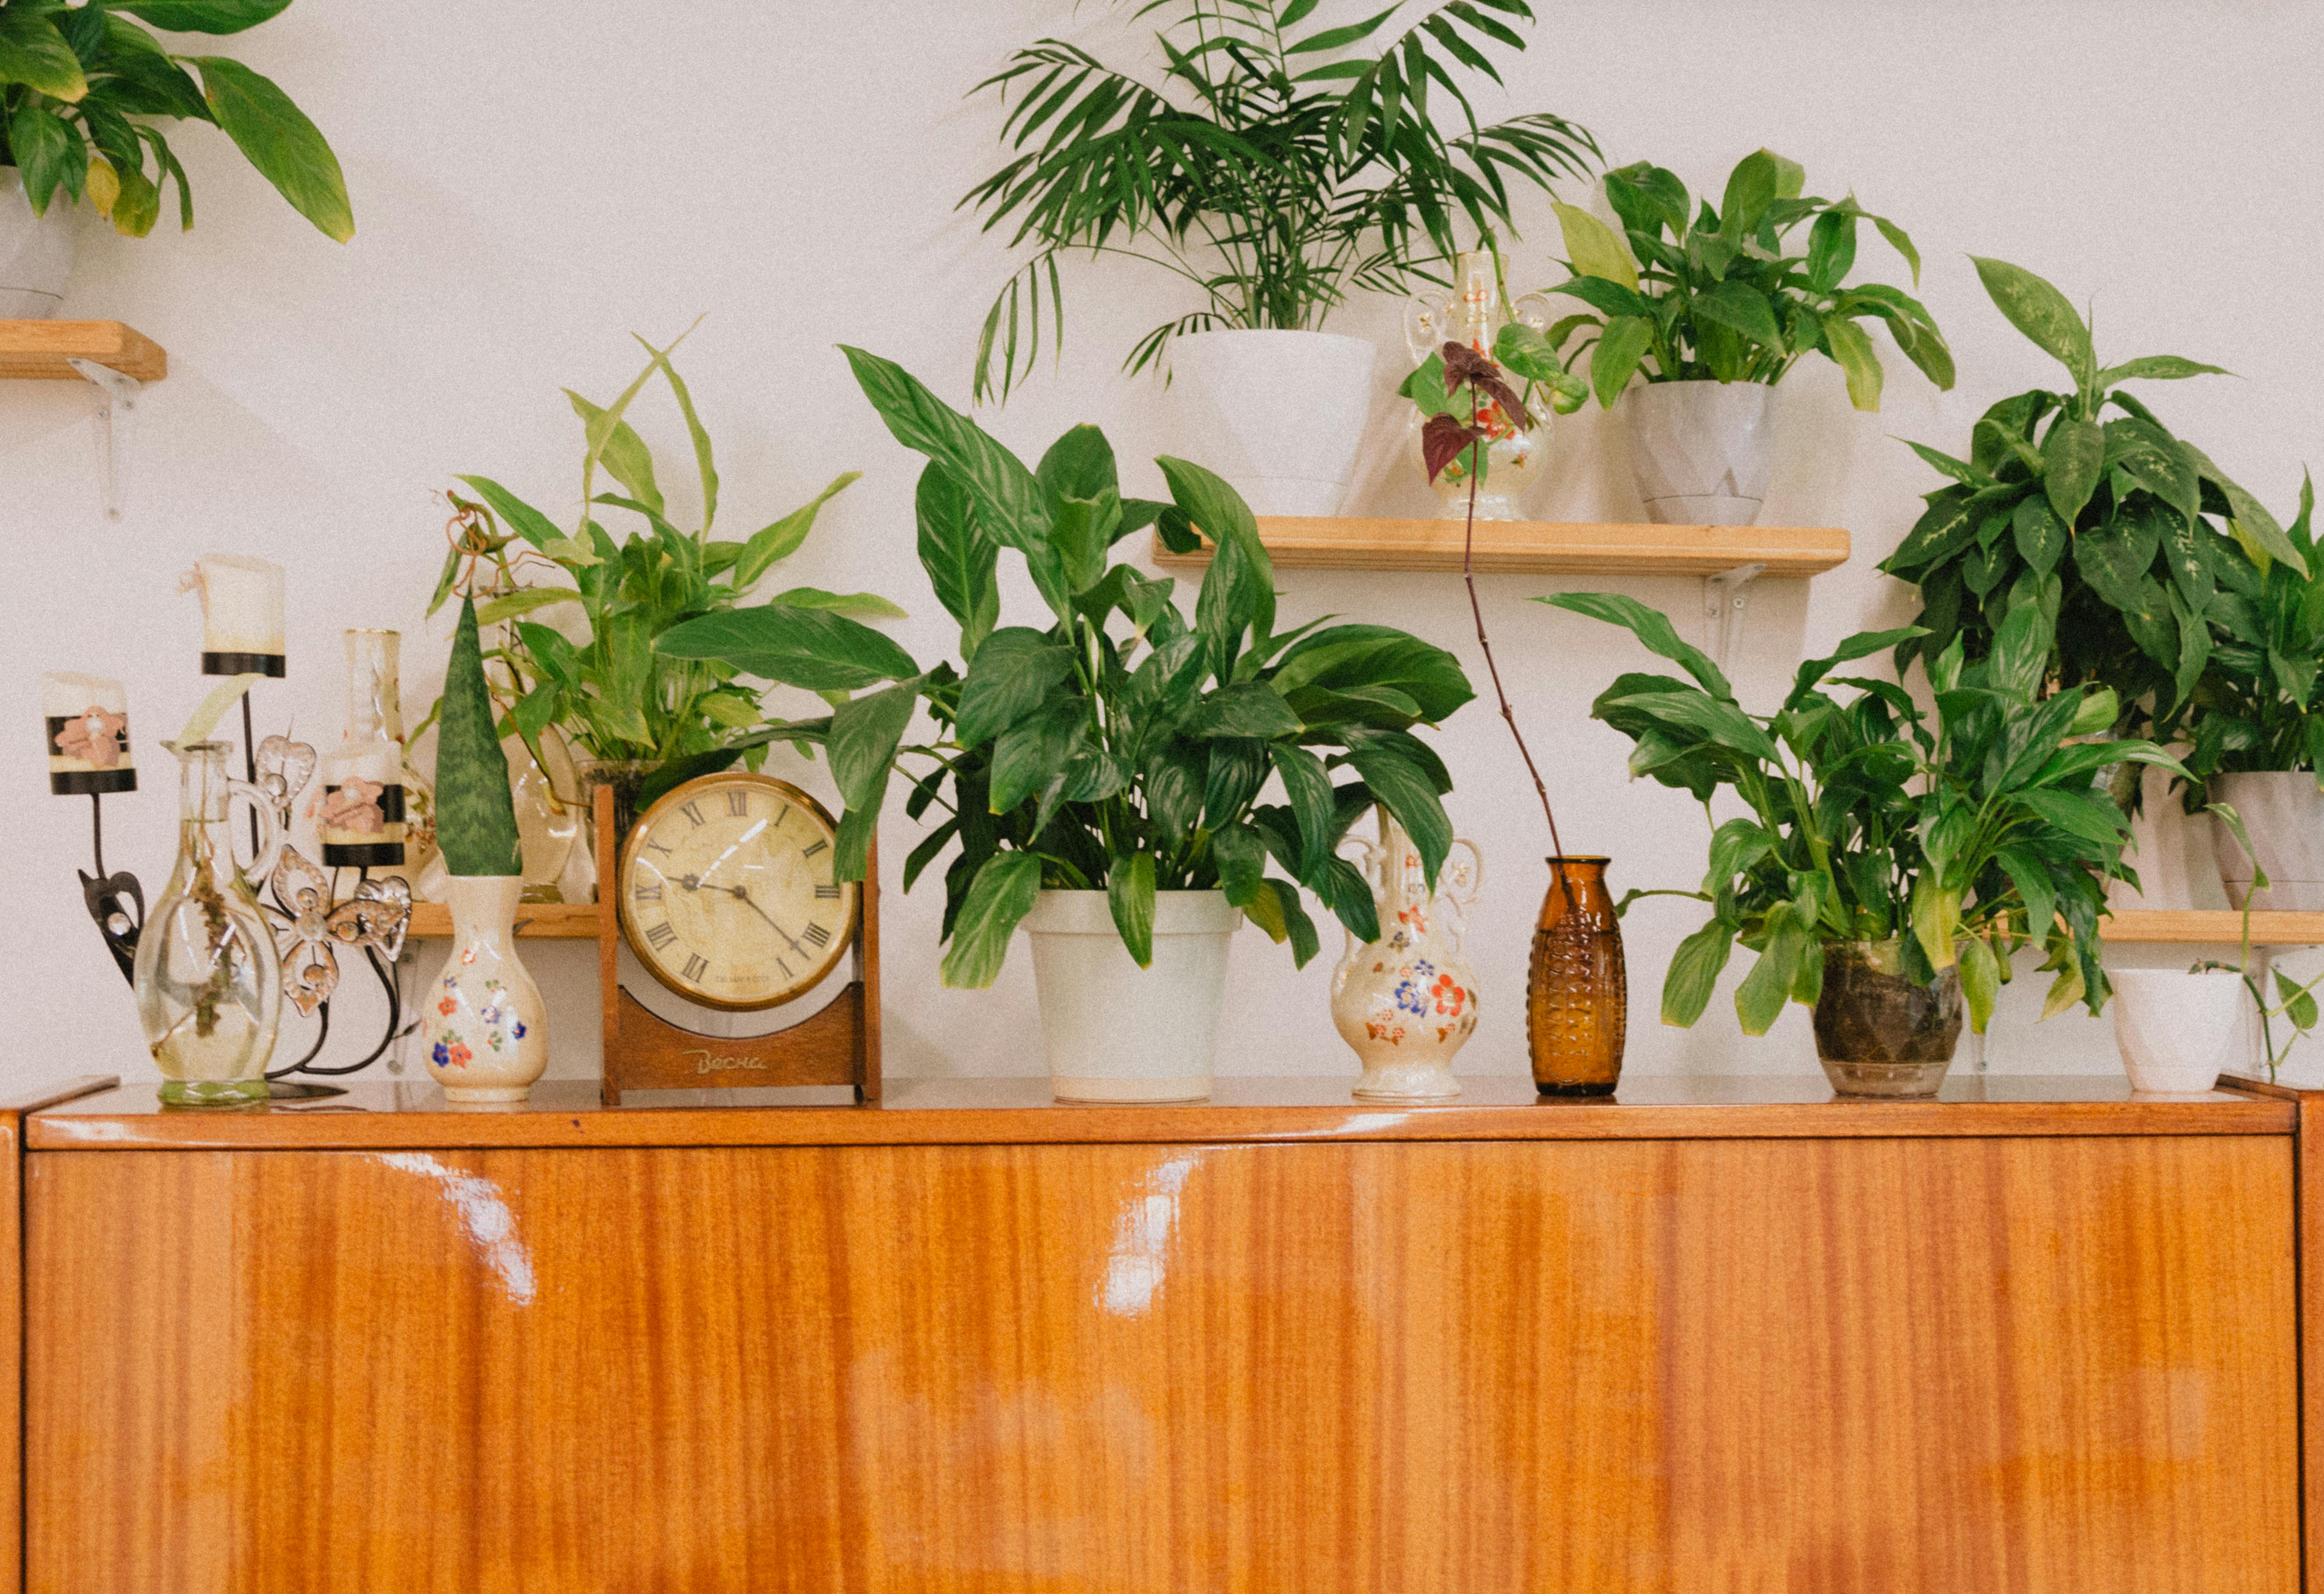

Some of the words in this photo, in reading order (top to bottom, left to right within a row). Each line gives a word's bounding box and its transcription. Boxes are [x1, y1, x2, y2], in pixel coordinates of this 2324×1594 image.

[726, 791, 748, 816] XII
[774, 804, 790, 827] I
[647, 839, 672, 859] X
[802, 839, 828, 859] II
[814, 885, 840, 899] III
